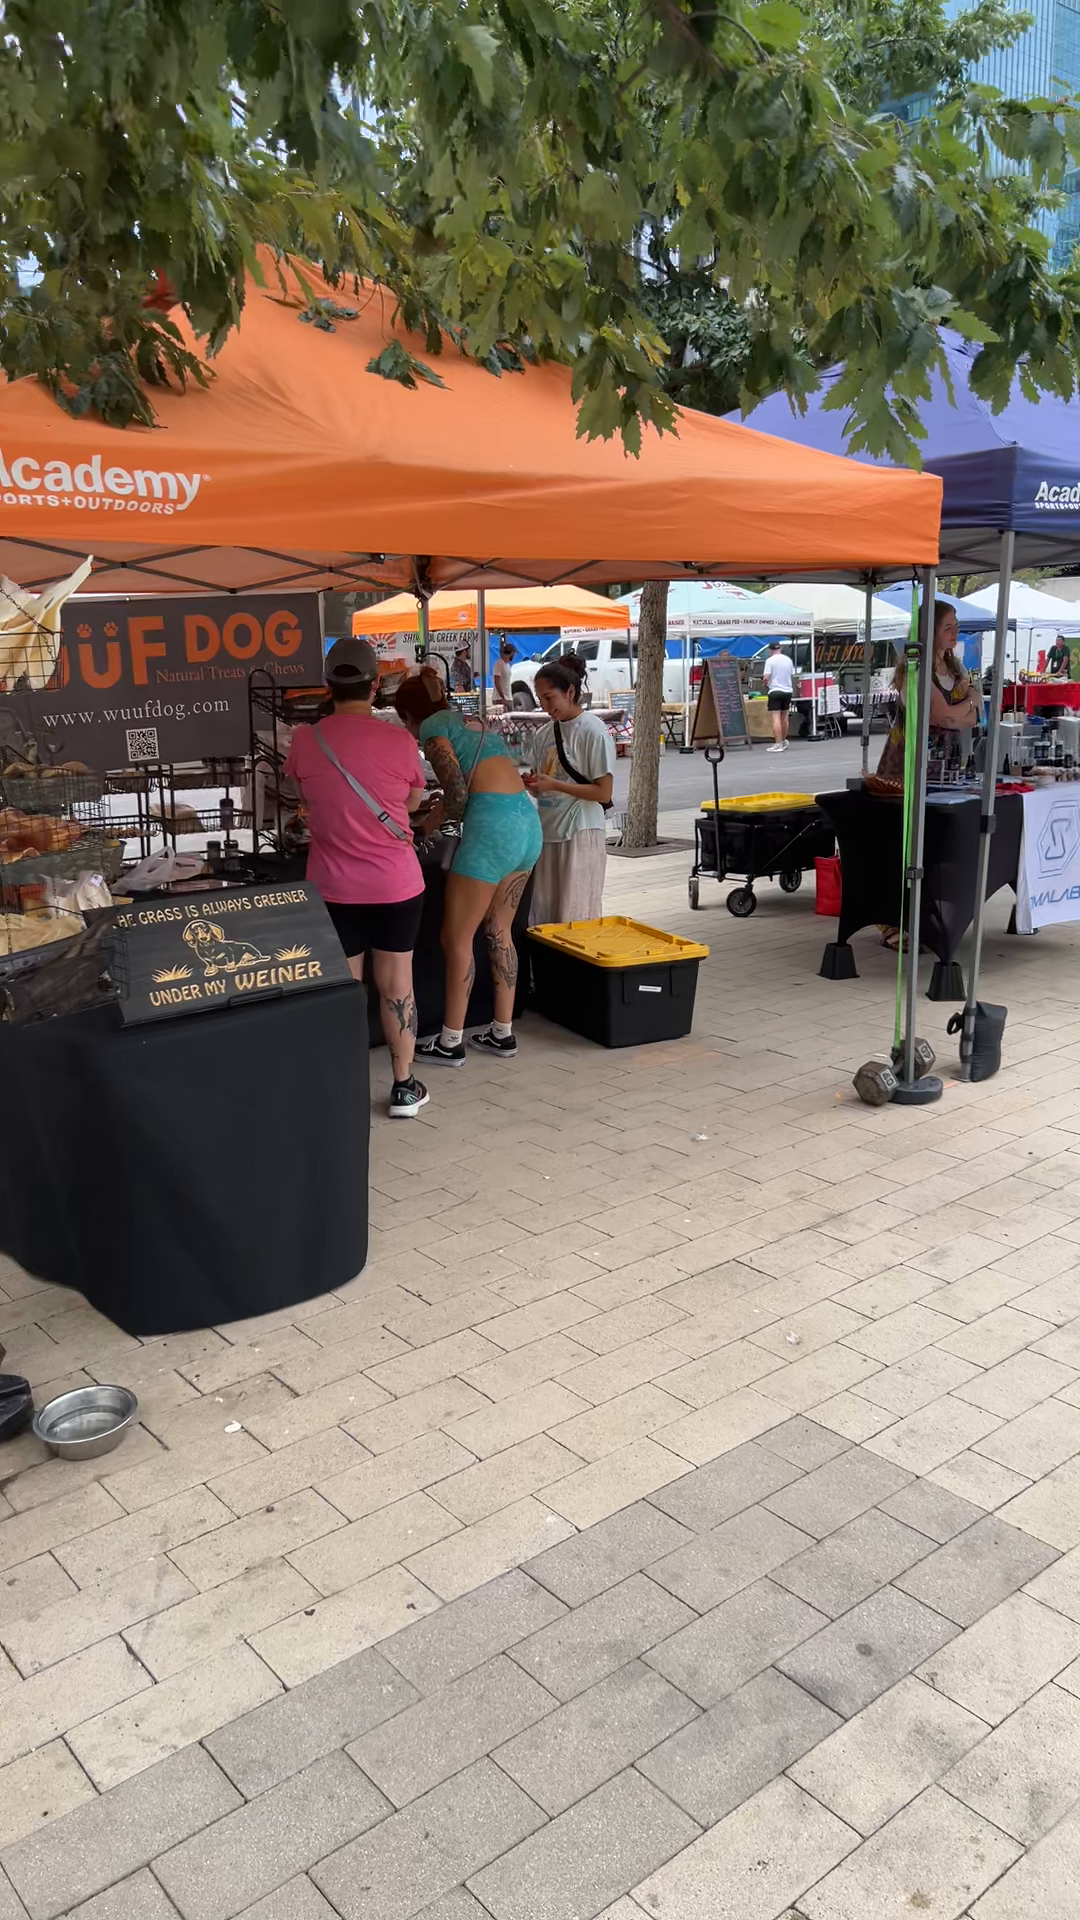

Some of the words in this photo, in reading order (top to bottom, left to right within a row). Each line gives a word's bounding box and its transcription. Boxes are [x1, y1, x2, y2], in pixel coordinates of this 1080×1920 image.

[183, 610, 304, 663] DOG
[436, 632, 458, 643] CREEK
[155, 666, 205, 684] Natural
[207, 665, 246, 680] Treats
[263, 661, 305, 676] Chews
[43, 698, 230, 728] www.wuufdog.com
[112, 914, 137, 929] HE
[138, 907, 183, 926] GRASS
[184, 904, 199, 919] IS
[202, 896, 251, 916] ALWAYS
[253, 888, 308, 910] GREENER
[149, 984, 202, 1008] UNDER
[204, 980, 226, 997] MY
[234, 960, 323, 992] WEINER
